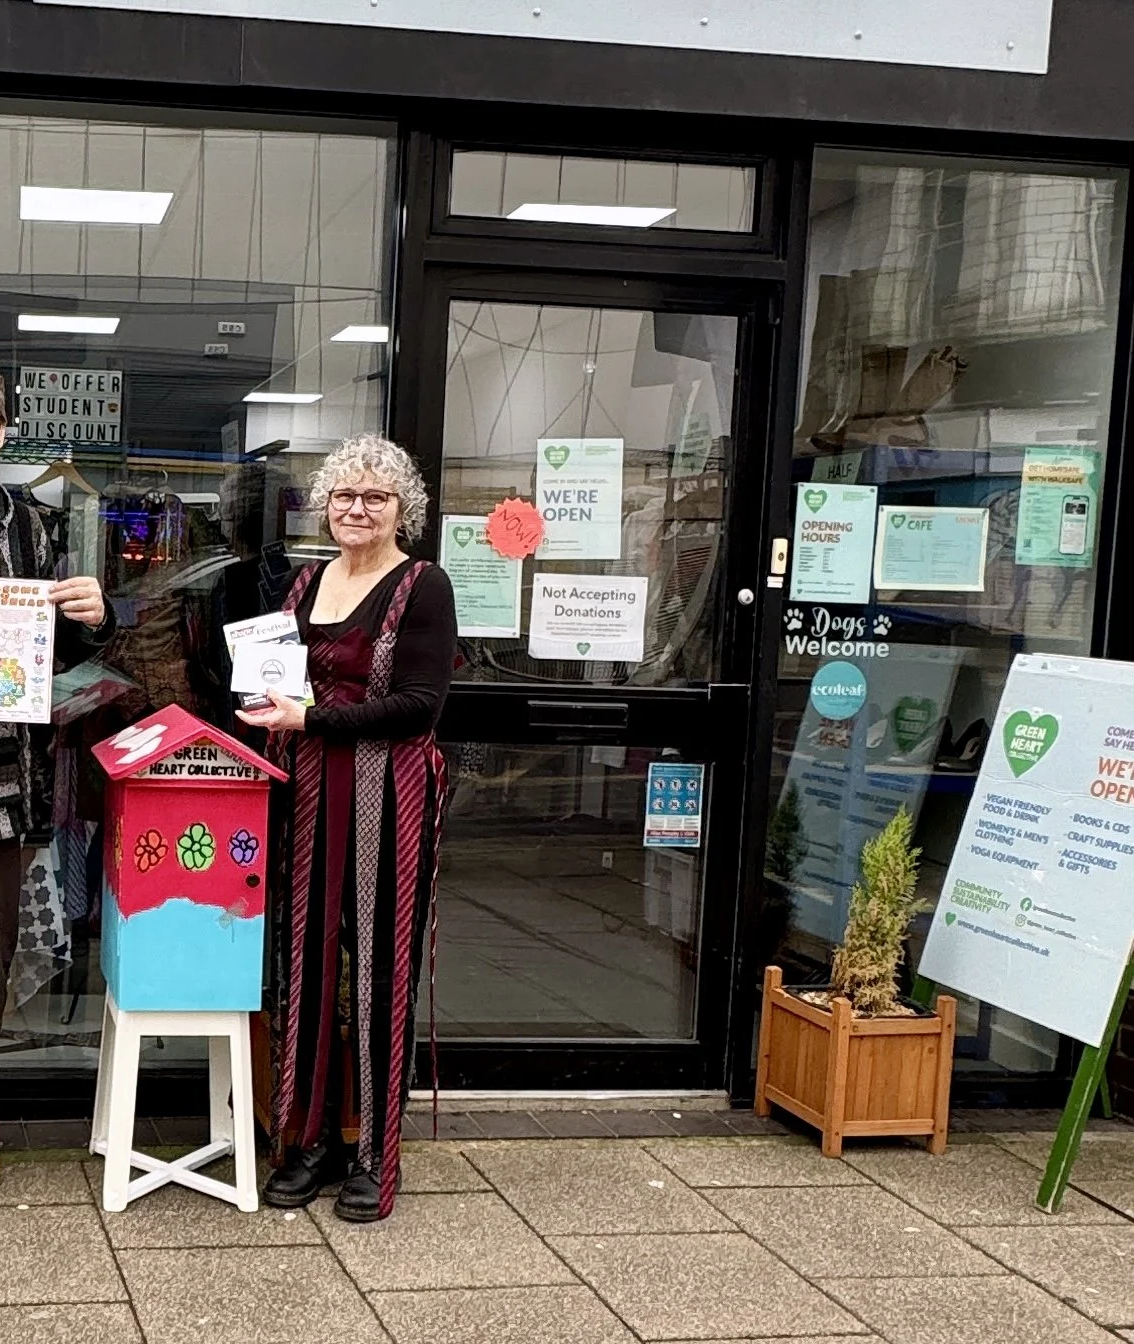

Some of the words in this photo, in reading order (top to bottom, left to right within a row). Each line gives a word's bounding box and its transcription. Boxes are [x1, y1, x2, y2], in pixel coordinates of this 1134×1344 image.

[24, 372, 47, 389] WE
[61, 373, 121, 394] OFFER
[22, 396, 106, 417] STUDENT
[20, 421, 119, 441] DISCOUNT
[827, 463, 853, 480] HALF
[543, 489, 599, 504] WE'RE
[542, 507, 593, 522] OPEN
[497, 508, 539, 549] NOW!
[801, 520, 854, 533] OPENING
[907, 519, 934, 531] CAFE
[800, 531, 841, 544] HOURS
[542, 586, 567, 599] Not
[569, 587, 636, 605] Accepting
[554, 604, 622, 619] Donations
[811, 607, 868, 640] Dogs
[785, 634, 890, 658] Welcome
[812, 682, 865, 697] ecoleaf
[1015, 724, 1047, 740] GREEN
[1010, 737, 1044, 754] HEART
[1103, 737, 1122, 749] SAY
[173, 746, 218, 761] GREEN
[149, 763, 185, 775] HEART
[187, 764, 252, 778] COLLECTIVE
[983, 803, 1006, 816] FOOD
[986, 793, 1014, 806] VEGAN
[1015, 800, 1052, 816] FRIENDLY
[1072, 813, 1103, 828] BOOKS
[975, 829, 1014, 847] CLOTHING
[1067, 830, 1095, 845] CRAFT
[1095, 837, 1134, 855] SUPPLIES
[970, 844, 992, 860] YOGA
[992, 849, 1040, 871] EQUIPMENT
[1061, 848, 1118, 871] ACCESSORIES
[1066, 861, 1090, 875] GIFTS
[955, 878, 1003, 900] COMMUNITY
